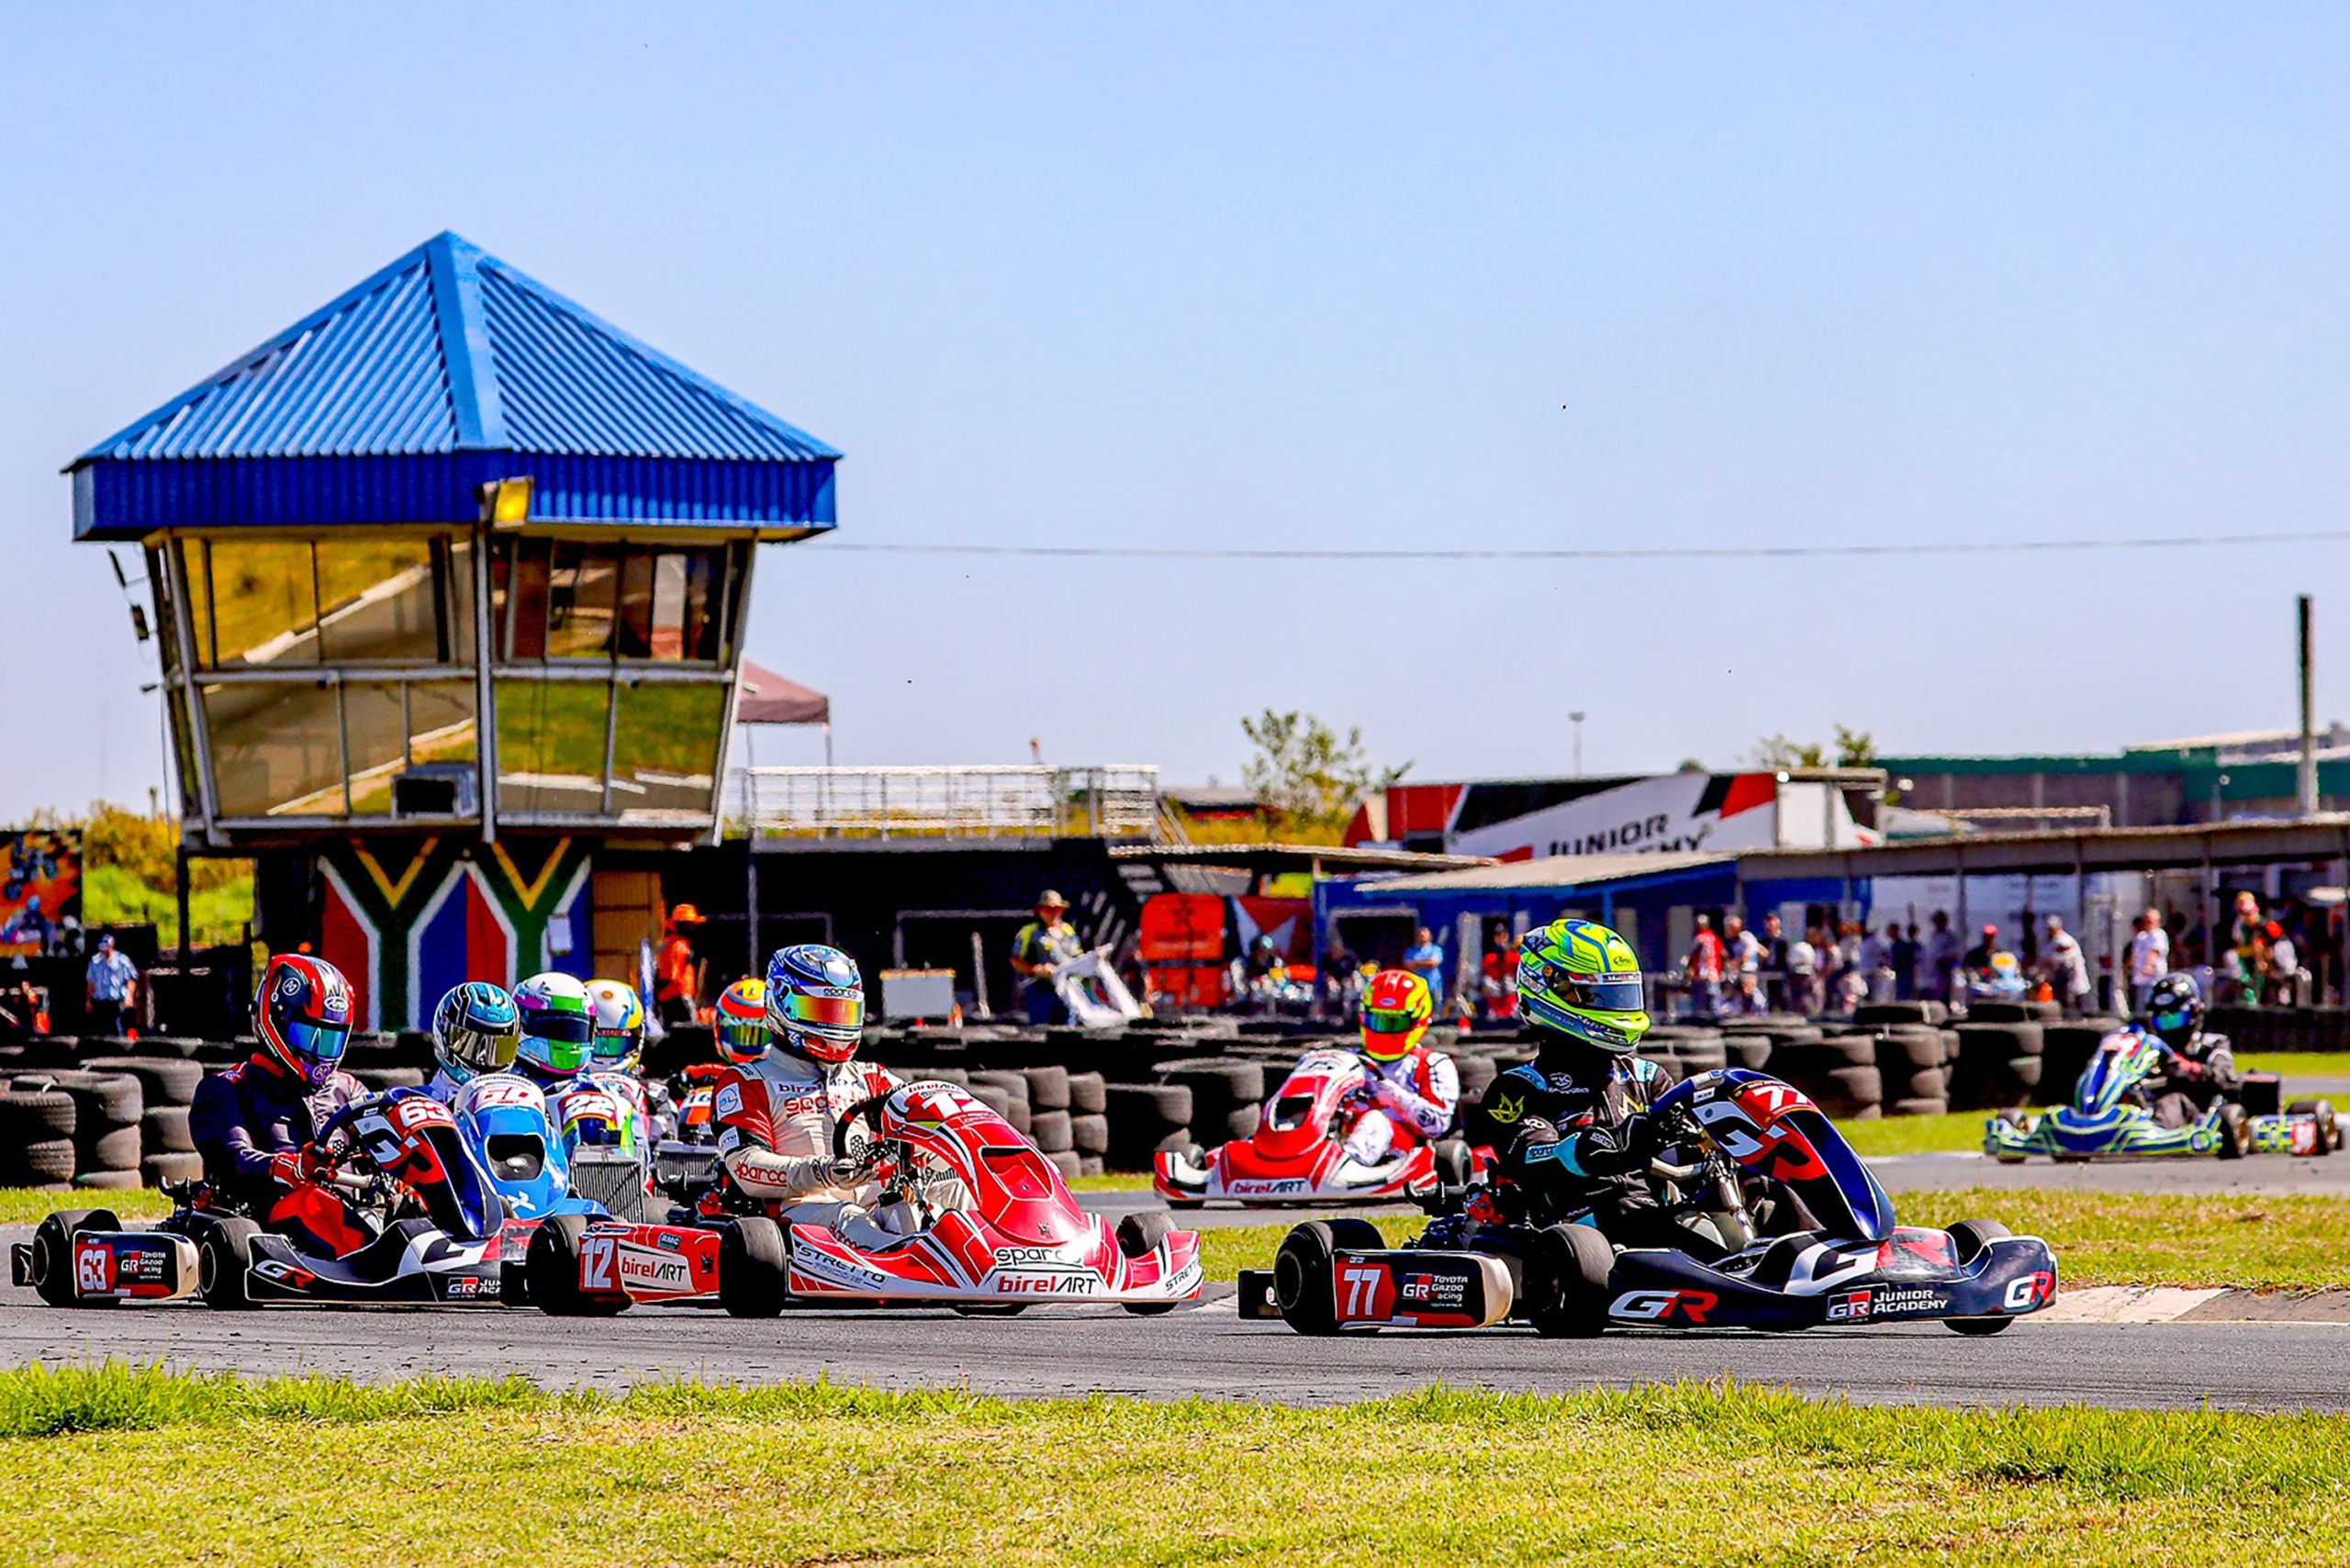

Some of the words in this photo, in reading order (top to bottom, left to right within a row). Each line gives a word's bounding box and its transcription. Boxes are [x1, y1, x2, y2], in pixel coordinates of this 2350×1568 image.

[399, 1102, 457, 1127] 63
[79, 1249, 106, 1290] 63
[120, 1260, 139, 1272] GR
[582, 1238, 614, 1288] 12
[621, 1256, 687, 1282] birelART
[255, 1260, 317, 1289] GR
[1434, 1275, 1468, 1283] TOYOTA
[448, 1283, 477, 1294] GR
[999, 1275, 1097, 1294] birelART
[1344, 1269, 1381, 1316] 77
[1403, 1283, 1429, 1298] GR
[1431, 1283, 1464, 1292] GAZOO
[2004, 1271, 2053, 1308] GR
[1608, 1289, 1718, 1323] GR
[1874, 1290, 1934, 1304] JUNIOR
[1830, 1301, 1870, 1319] GR
[1874, 1299, 1948, 1315] ACADEMY
